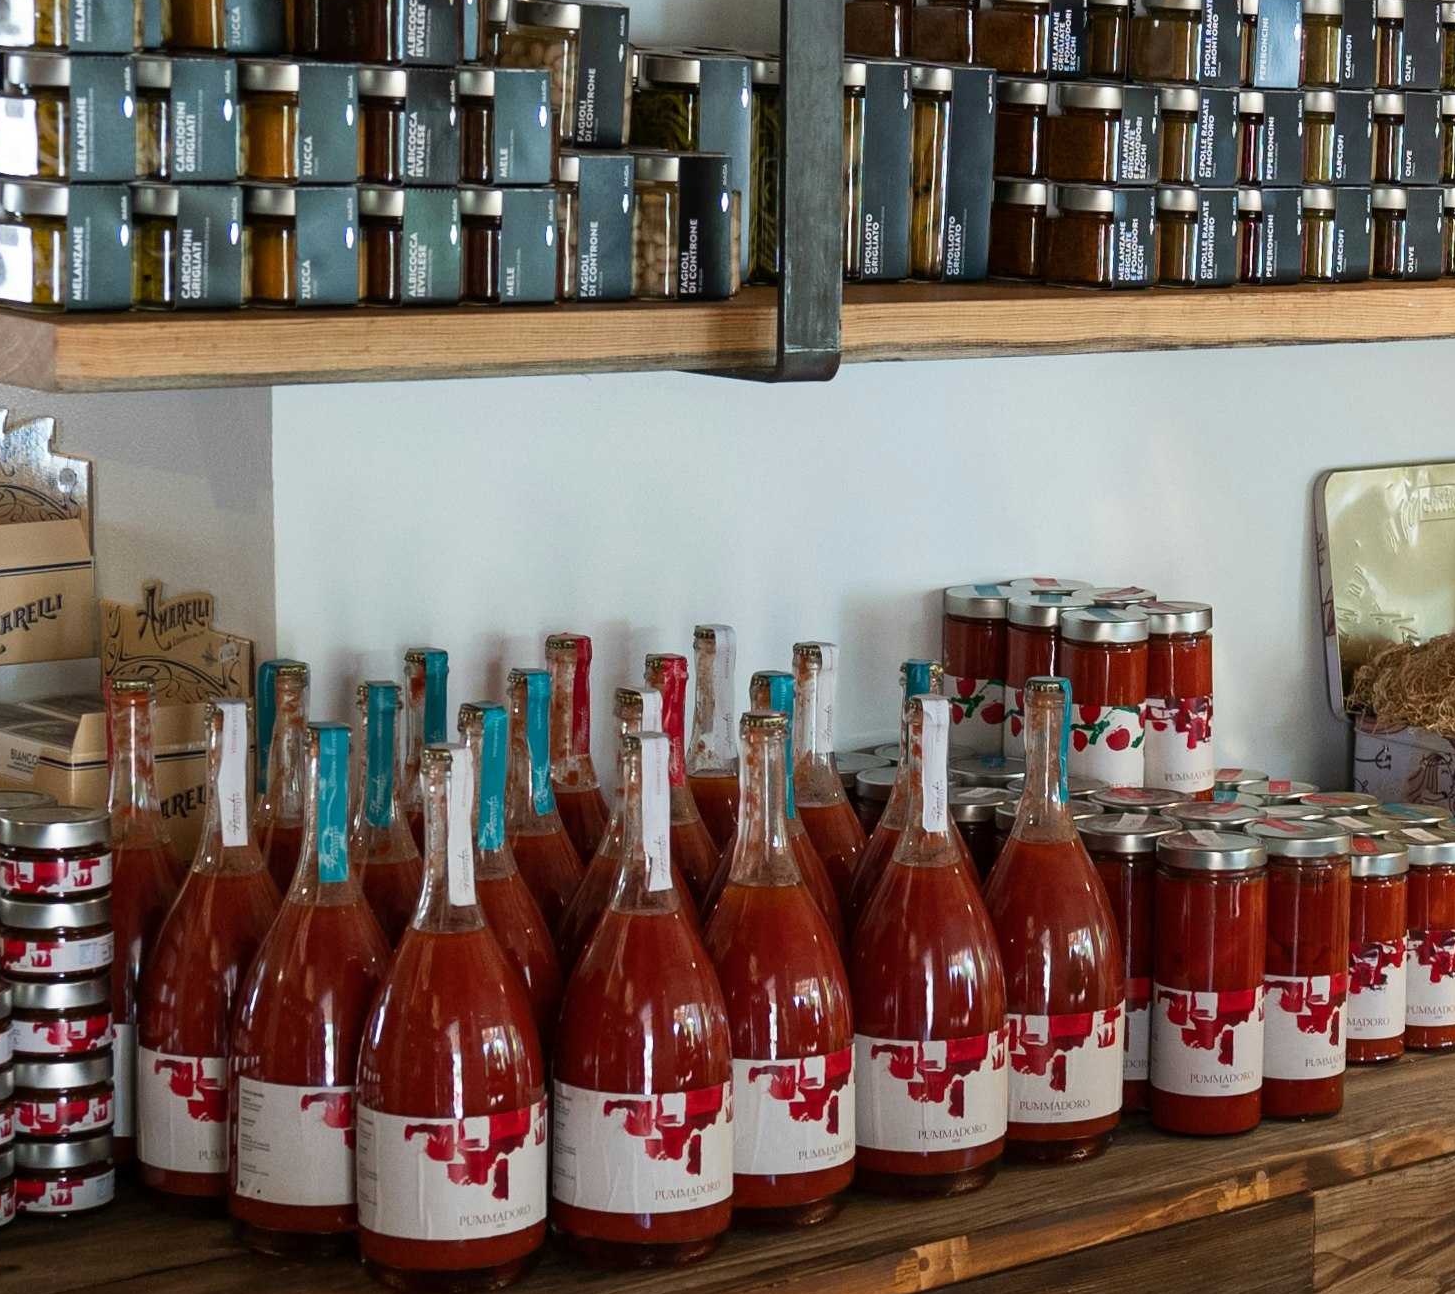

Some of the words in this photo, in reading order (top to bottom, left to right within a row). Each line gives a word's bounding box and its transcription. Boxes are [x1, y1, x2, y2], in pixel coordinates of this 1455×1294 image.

[1204, 37, 1212, 77] CIPOLLE
[1212, 14, 1220, 62] MONTORO
[1259, 17, 1270, 82] PEPERONCINI
[1345, 34, 1353, 78] CARCIOFI
[587, 68, 597, 123] CONTRONE
[77, 98, 87, 173] MELANZANE
[577, 100, 588, 143] FAGIOLI
[303, 136, 312, 176] ZUCCA
[500, 148, 508, 177] MELE
[1122, 119, 1131, 180] MELANZANE
[1266, 116, 1275, 180] PEPERONCINI
[1336, 134, 1344, 179] CARCIOFI
[72, 226, 83, 300] MELANZANE
[181, 229, 192, 299] CARCIOFINI
[408, 232, 418, 297] ALBICOCCA
[589, 221, 599, 278] CONTRONE
[865, 213, 874, 275] CIPOLLOTTO
[872, 222, 880, 274] GRIGLIATO
[1408, 246, 1416, 273] OLIVE
[191, 242, 201, 300] GRIGLIATI
[301, 260, 311, 299] ZUCCA
[506, 267, 515, 296] MELE
[580, 255, 589, 297] FAGIOLI
[137, 589, 211, 648] AMARELLI
[1190, 1071, 1255, 1085] PUMMADORO
[1019, 1098, 1092, 1112] PUMMADORO
[917, 1122, 989, 1140] PUMMADORO
[654, 1180, 722, 1201] PUMMADORO
[459, 1204, 532, 1227] PUMMADORO
